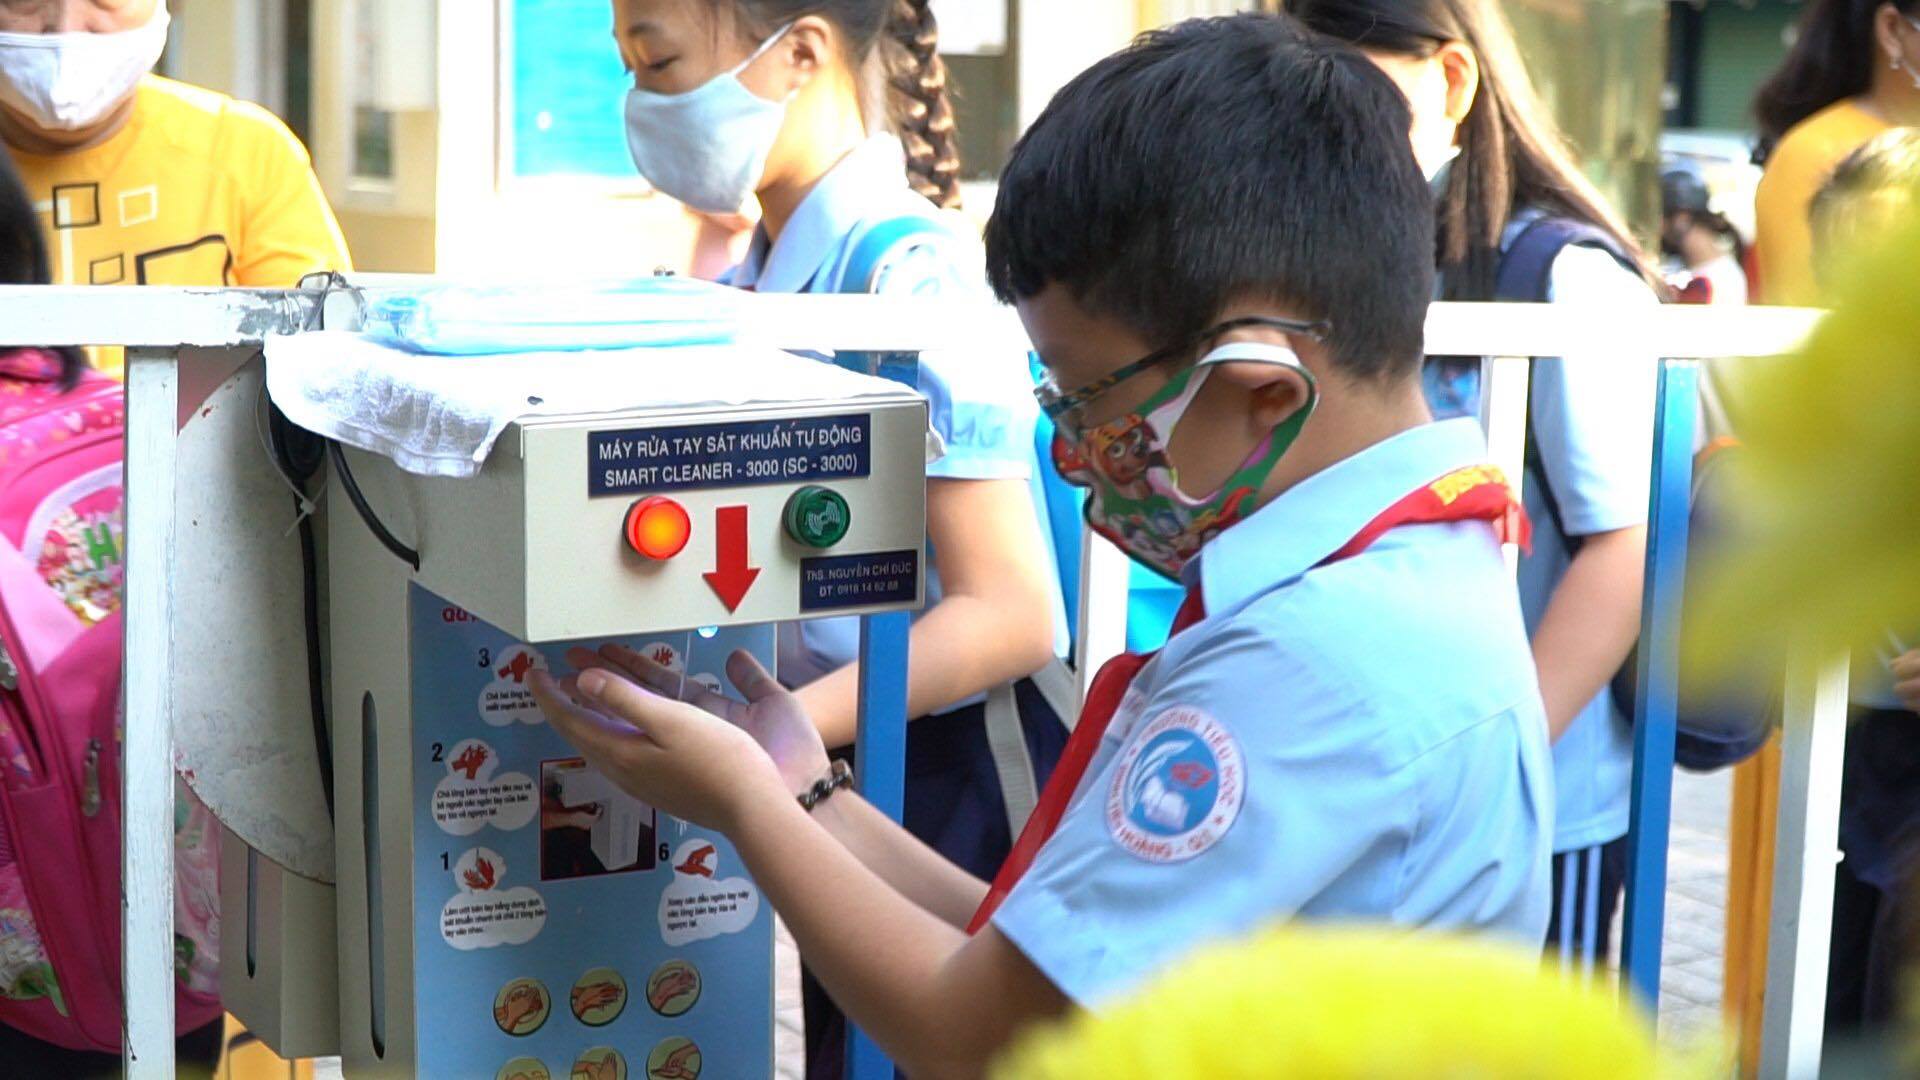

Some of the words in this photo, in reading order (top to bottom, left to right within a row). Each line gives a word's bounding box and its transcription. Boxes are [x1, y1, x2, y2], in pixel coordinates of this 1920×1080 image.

[599, 438, 633, 460] MÁY
[637, 434, 669, 458] RỬA
[673, 437, 703, 455] TAY
[706, 432, 737, 453] SÁT
[740, 422, 794, 450] KHUẨN
[795, 428, 815, 450] TỰ
[819, 424, 862, 448] ĐỘNG
[605, 467, 658, 488] SMART
[662, 462, 733, 483] CLEANER
[746, 459, 779, 478] 3000
[783, 456, 808, 478] (SC
[820, 453, 858, 474] 3000)
[478, 647, 490, 668] 3
[432, 742, 443, 762] 2
[440, 851, 449, 871] 1
[658, 843, 670, 861] 6
